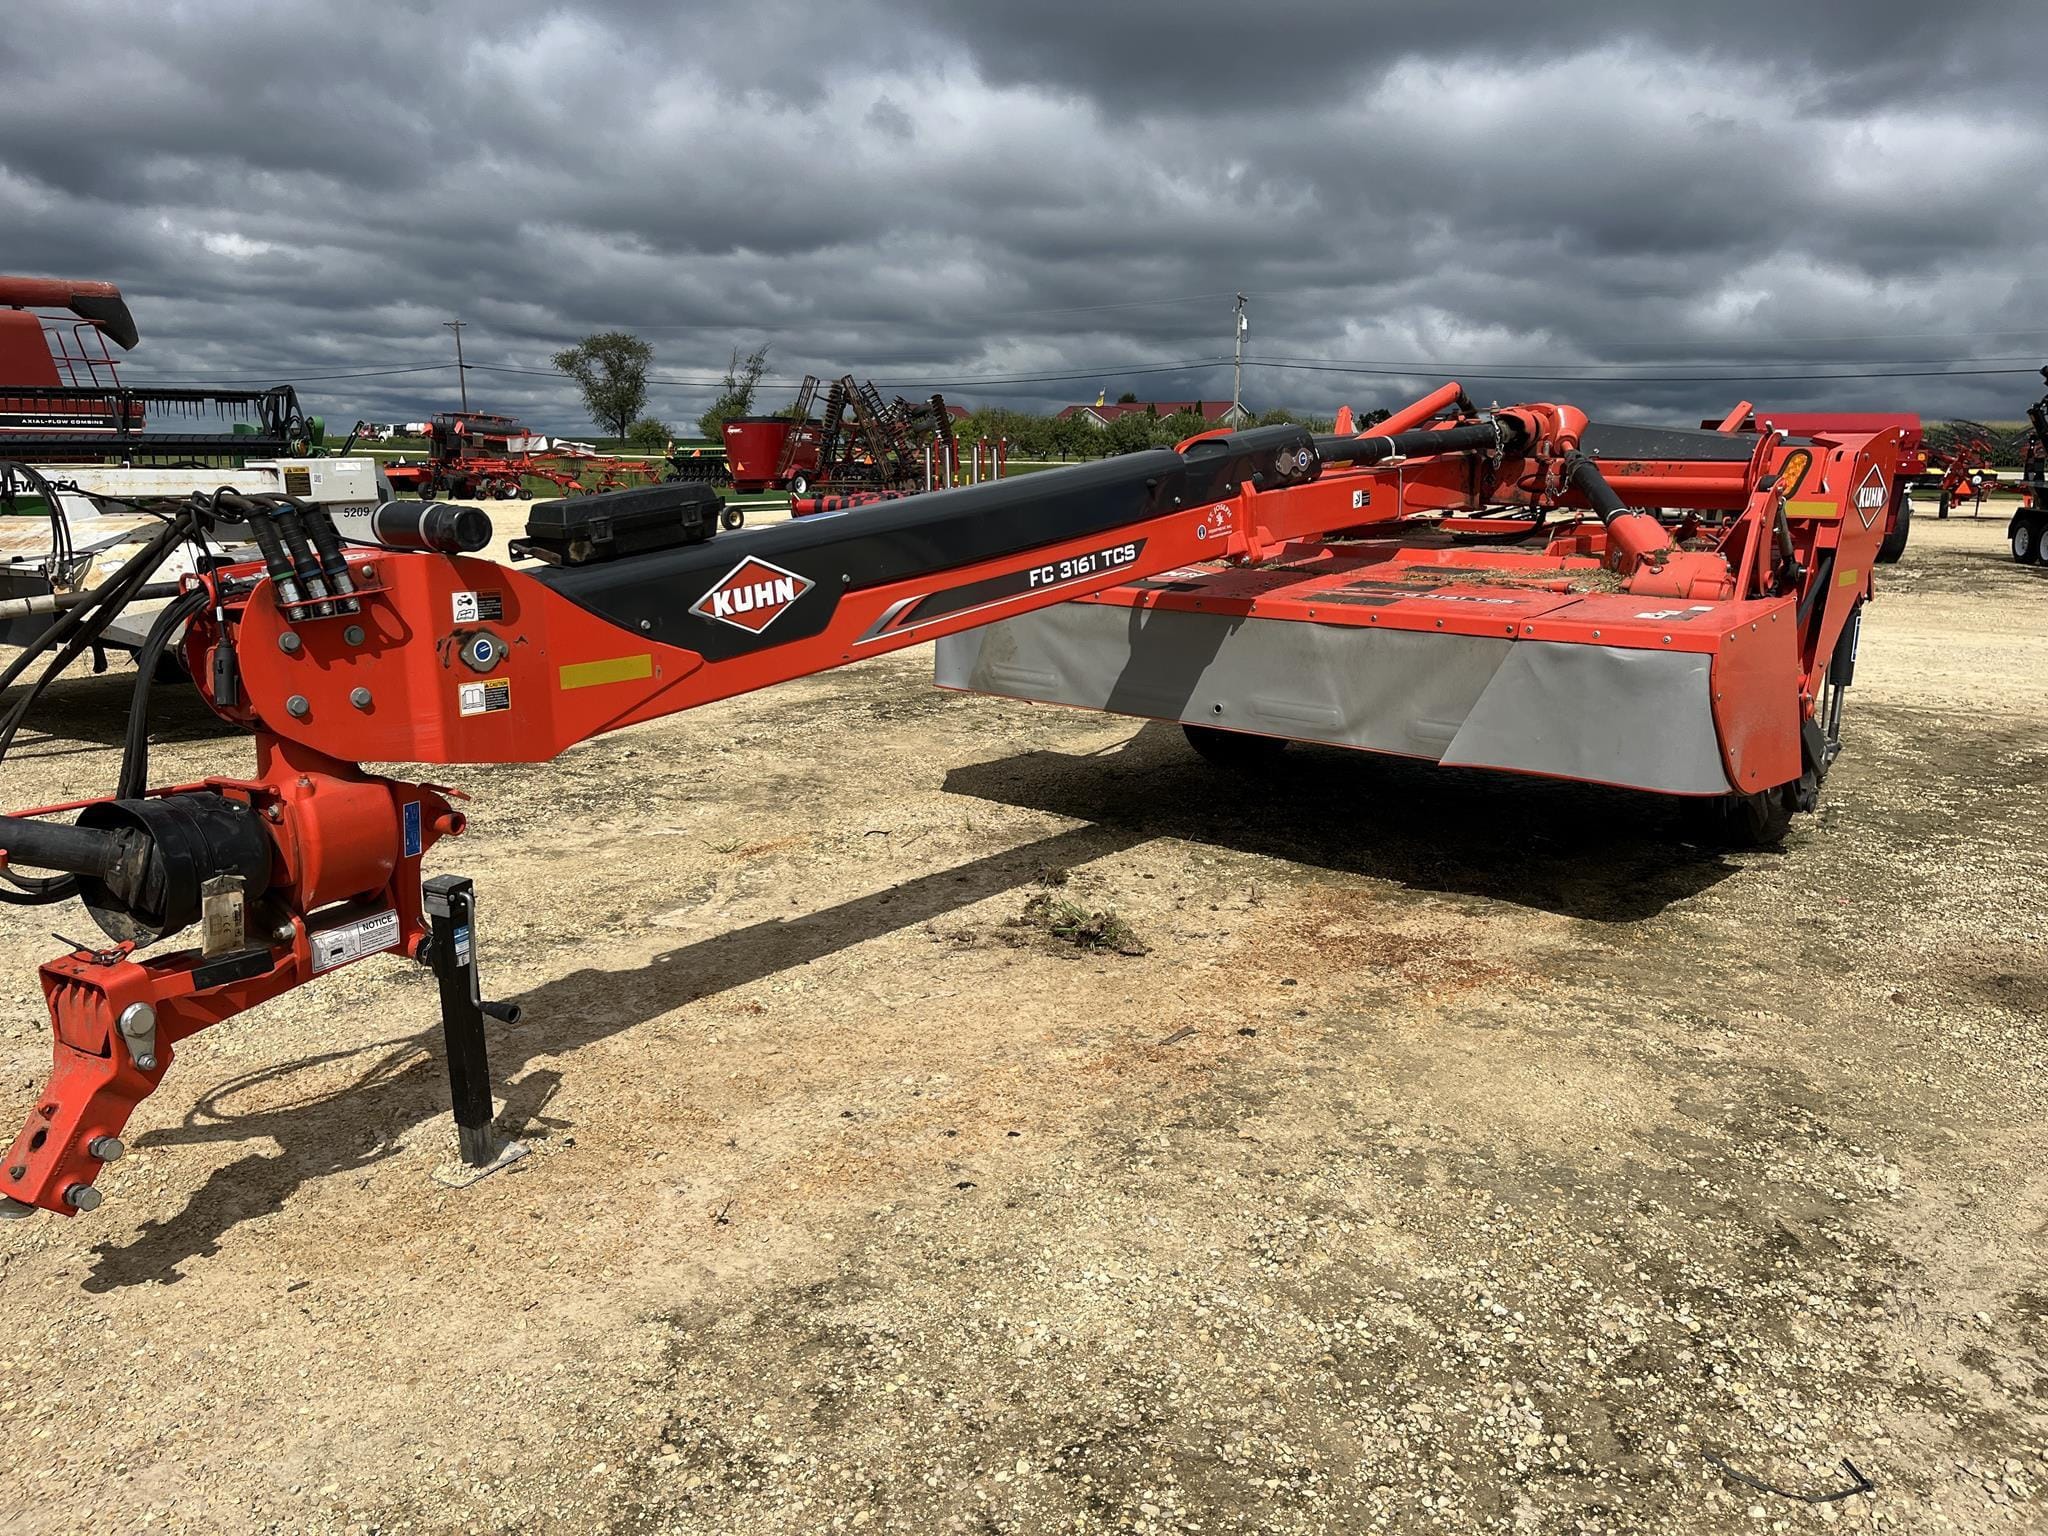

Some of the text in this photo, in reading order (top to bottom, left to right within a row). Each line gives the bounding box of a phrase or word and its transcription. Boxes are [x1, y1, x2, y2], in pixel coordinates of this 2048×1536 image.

[1858, 487, 1884, 507] KUHN
[343, 506, 370, 518] 5209
[1029, 544, 1136, 588] FC 3161 TCS
[712, 576, 796, 618] KUHN
[362, 914, 393, 931] NOTICE
